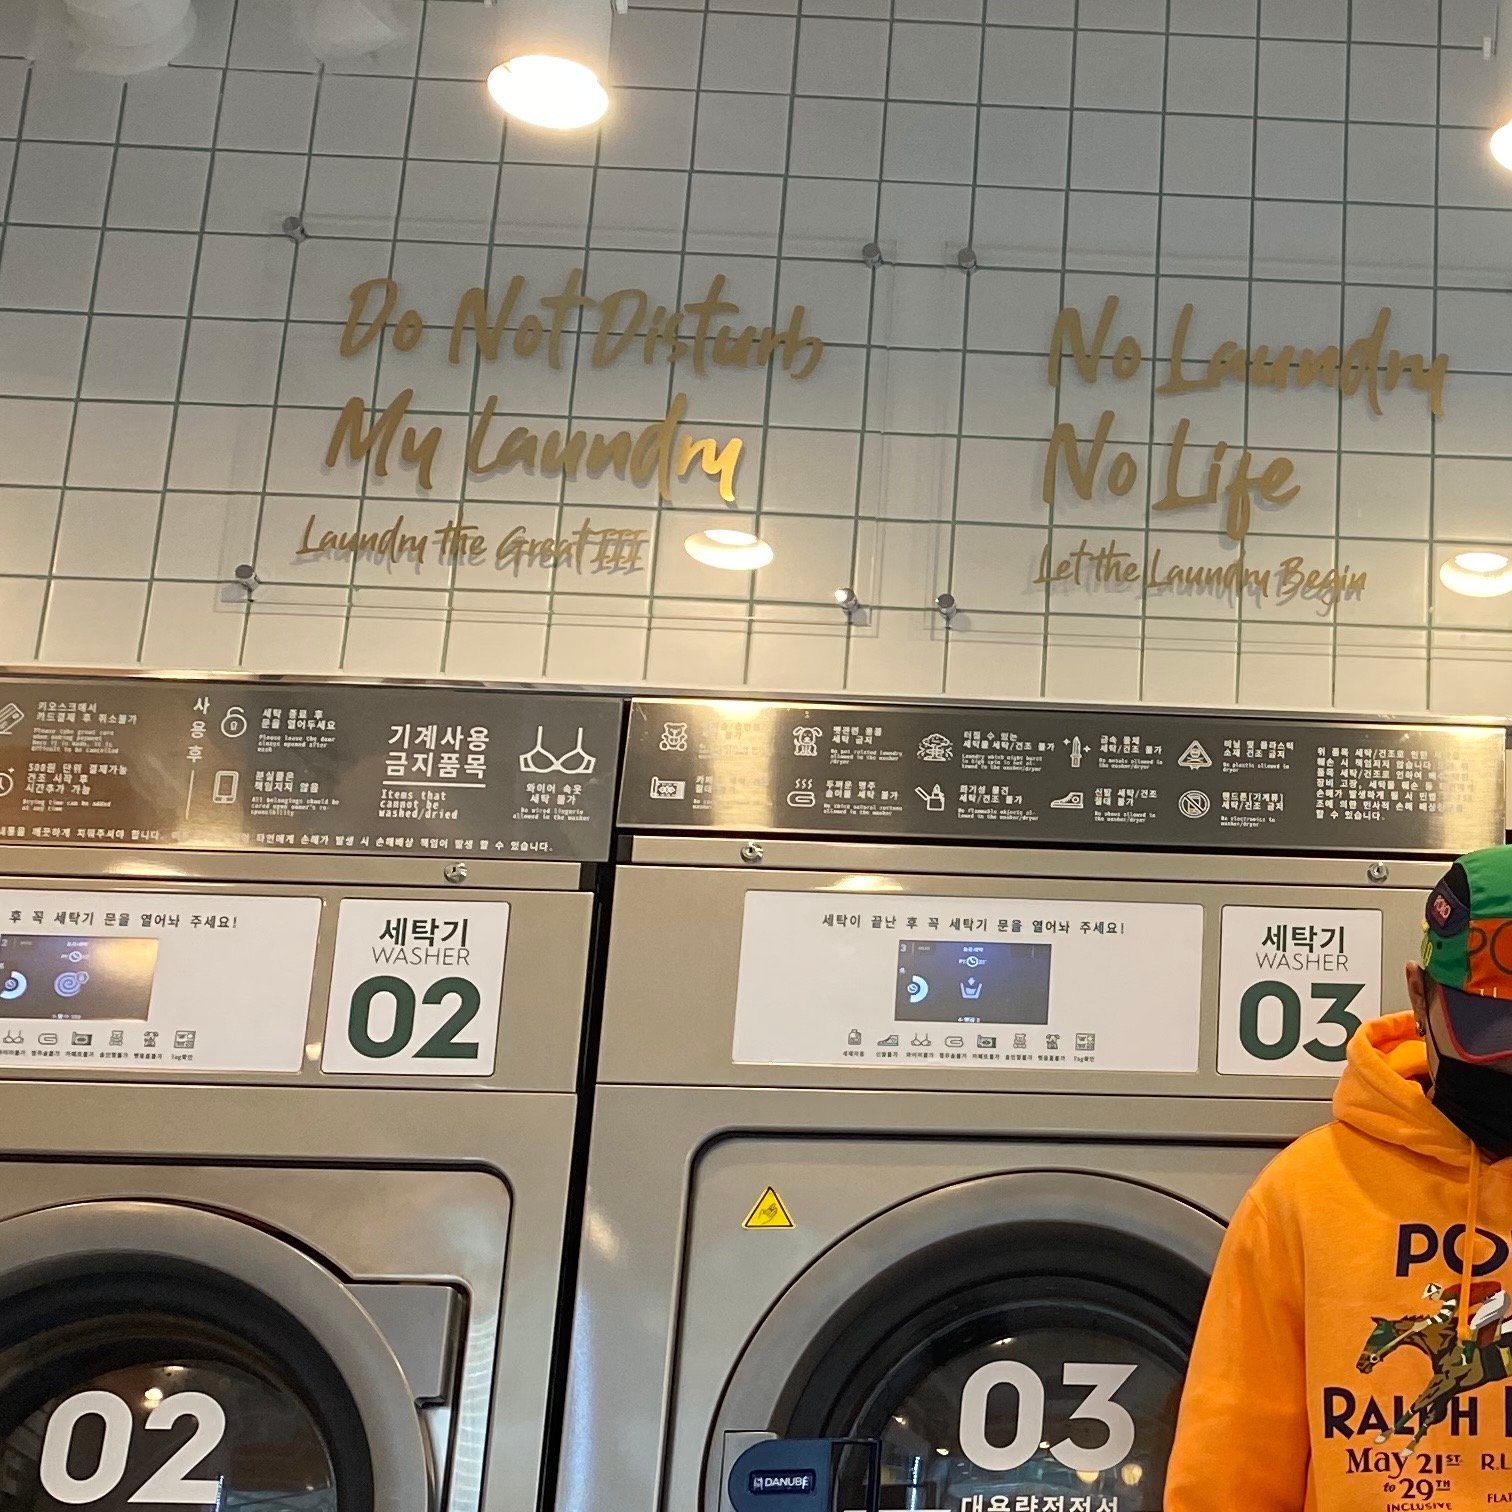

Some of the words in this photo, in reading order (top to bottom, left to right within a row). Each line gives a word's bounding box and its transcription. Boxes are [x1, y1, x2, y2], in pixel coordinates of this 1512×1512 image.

[340, 278, 423, 357] Do
[449, 269, 595, 369] Not
[593, 274, 824, 379] Disturb
[1047, 295, 1142, 386] No
[1155, 303, 1449, 417] Laundry
[325, 388, 443, 489] My
[1042, 410, 1137, 504] No
[1151, 418, 1301, 540] Life
[297, 514, 426, 564] Laundry
[434, 513, 487, 556] the
[496, 518, 590, 562] Great
[1032, 539, 1090, 585] Let
[1089, 539, 1140, 583] the
[1145, 541, 1270, 598] Laundry
[1279, 556, 1367, 606] Begin
[388, 724, 490, 751] 기계사용
[385, 752, 487, 779] 금지품목
[379, 800, 419, 809] cannot
[426, 801, 439, 810] be
[381, 789, 413, 800] Items
[422, 791, 447, 801] that
[378, 809, 458, 820] washed/dried
[9, 910, 22, 925] 후
[32, 910, 44, 925] 꼭
[54, 911, 94, 926] 세탁기
[104, 912, 130, 927] 문을
[189, 914, 238, 929] 주세요!
[379, 918, 469, 947] 세탁기
[822, 914, 862, 930] 세탁이
[871, 915, 897, 930] 끝난
[906, 916, 919, 931] 후
[928, 917, 941, 931] 꼭
[949, 917, 988, 932] 세탁기
[997, 918, 1022, 933] 문을
[1032, 919, 1070, 935] 열어놔
[1079, 920, 1125, 936] 주세요!
[1262, 925, 1345, 953] 세탁기
[371, 946, 471, 966] WASHER
[1255, 952, 1348, 971] WASHER
[348, 975, 481, 1059] 02
[1239, 980, 1366, 1062] 03
[958, 1360, 1139, 1472] 03
[39, 1390, 226, 1504] 02
[1345, 1447, 1408, 1479] May
[1383, 1482, 1396, 1492] to
[1387, 1502, 1452, 1512] INCLUSIVE
